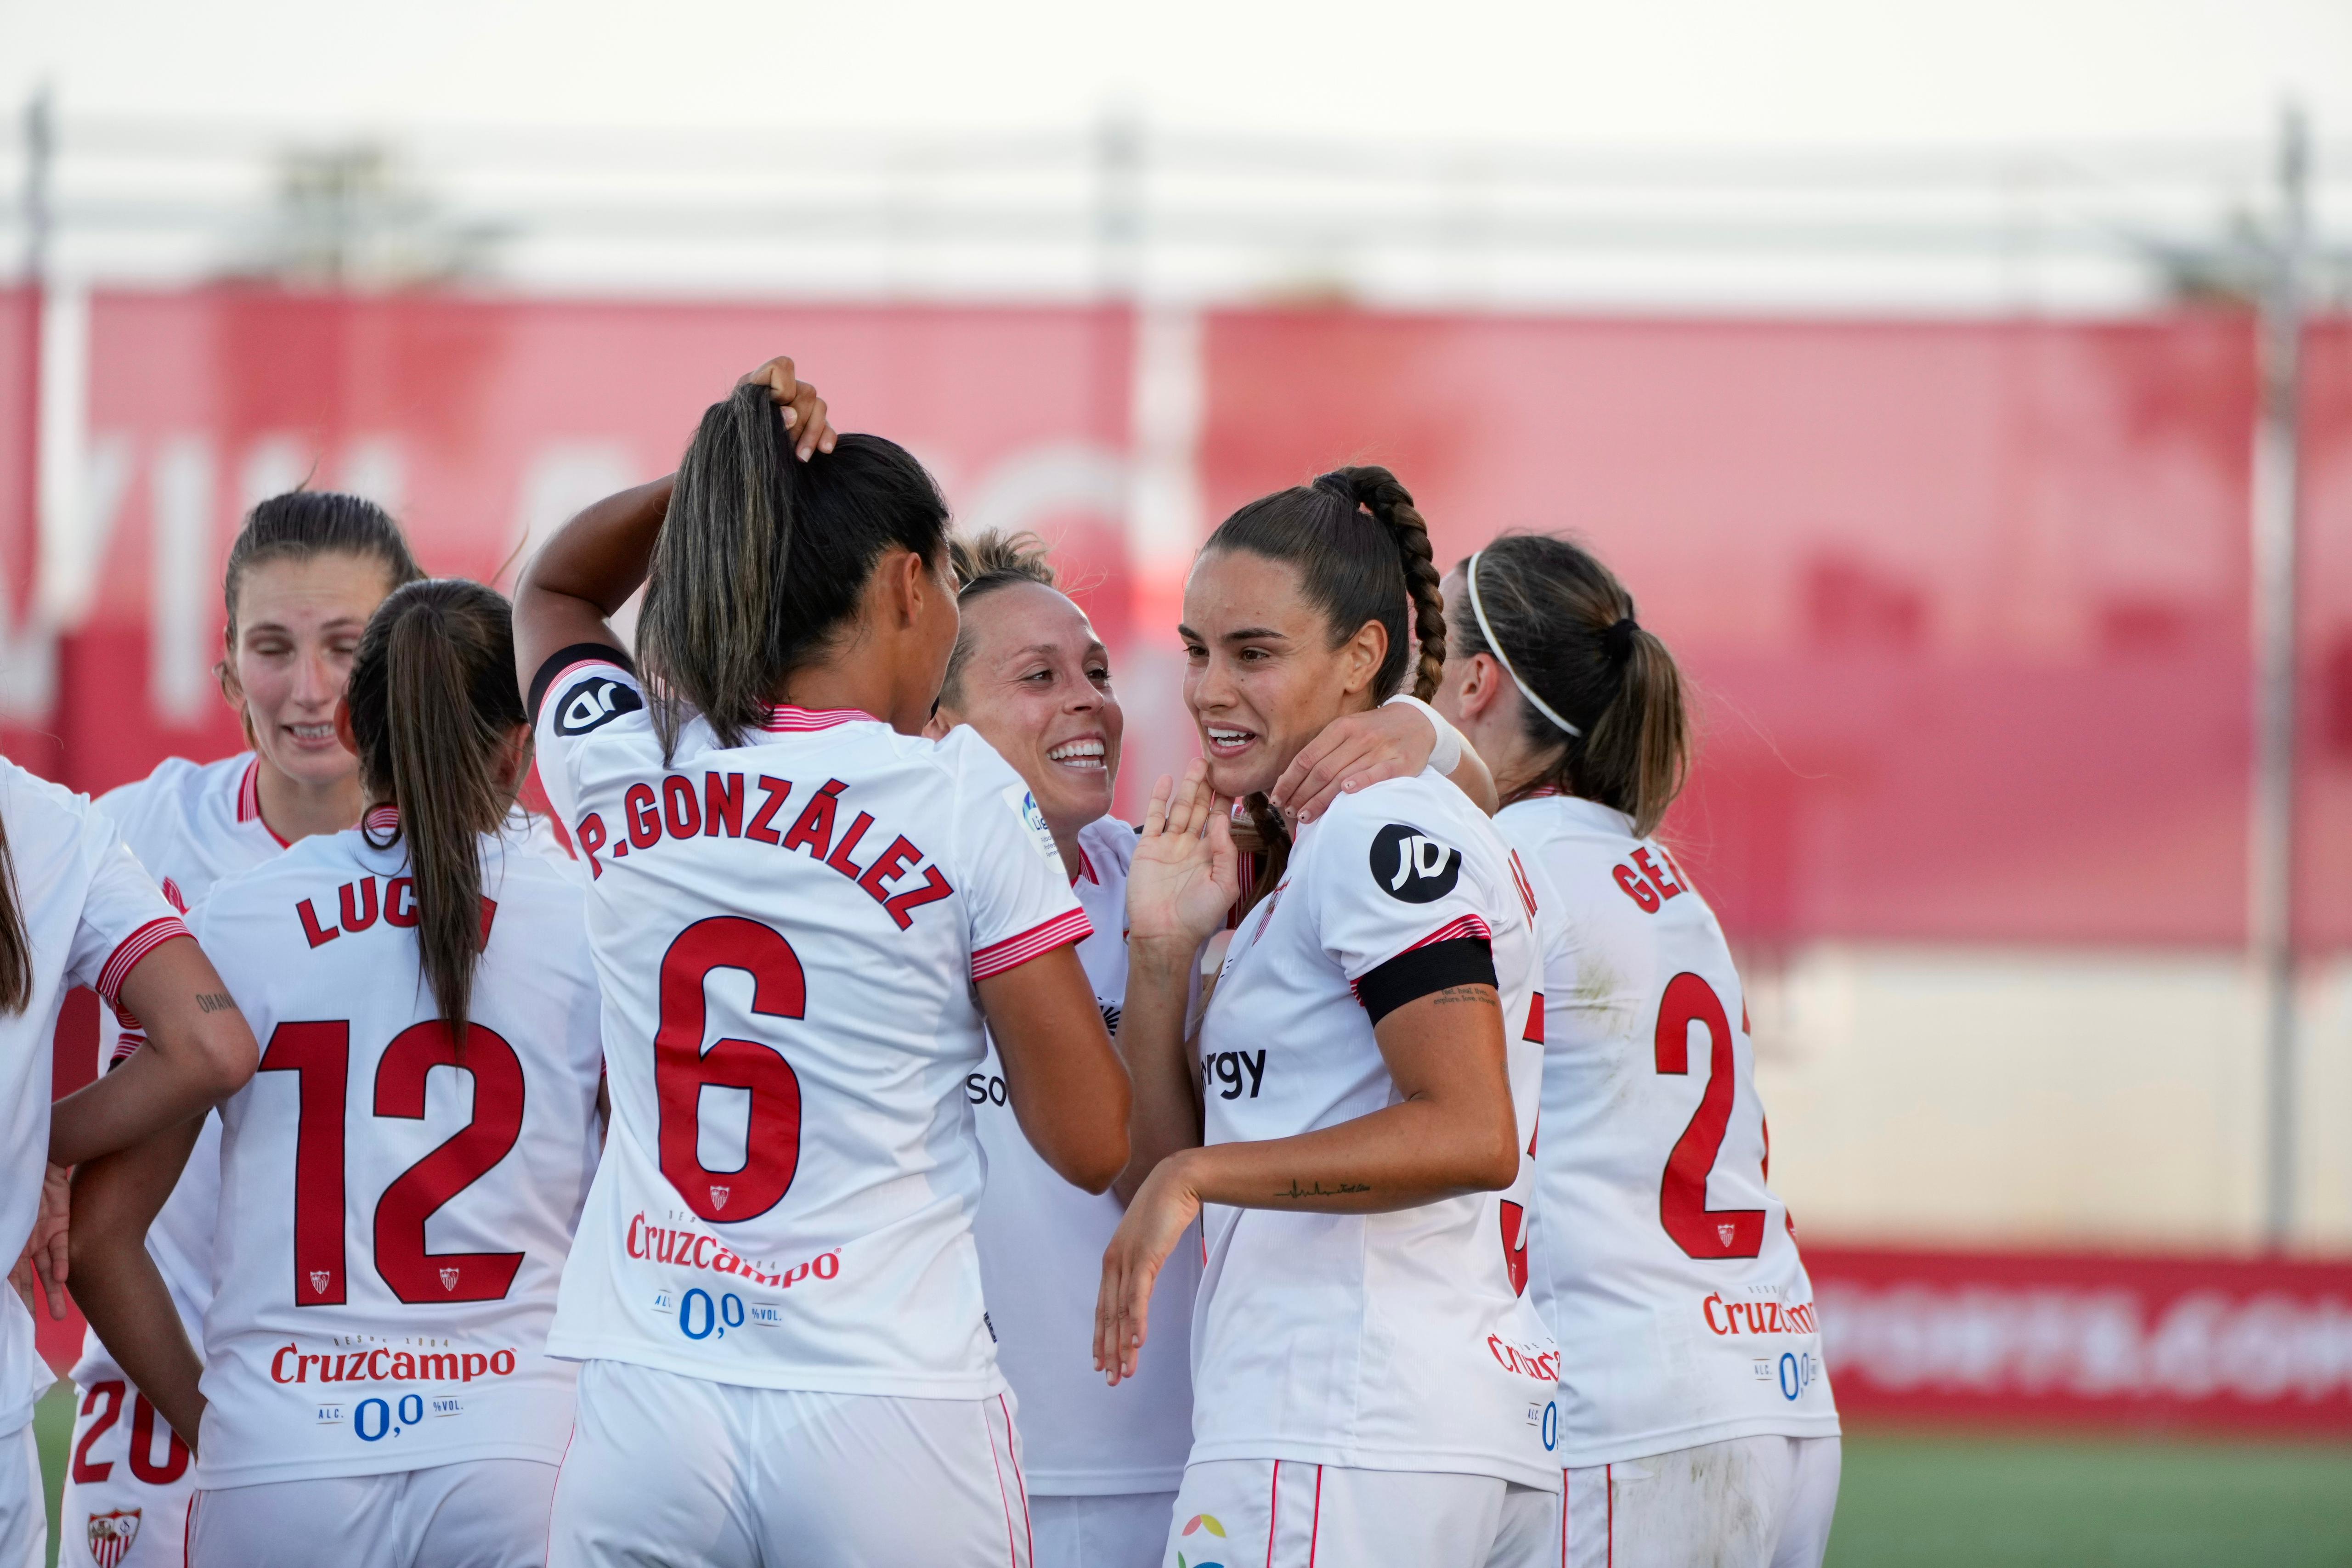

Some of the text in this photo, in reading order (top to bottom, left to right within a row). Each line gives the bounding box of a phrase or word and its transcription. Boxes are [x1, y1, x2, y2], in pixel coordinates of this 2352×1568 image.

[1391, 835, 1451, 891] JD
[654, 915, 806, 1224] 6
[257, 1019, 526, 1308] 12
[334, 1335, 386, 1346] DESDE
[679, 1288, 745, 1340] 0,0
[73, 1380, 190, 1485] 20
[318, 1408, 344, 1420] ALC.
[354, 1394, 423, 1441] 0,0
